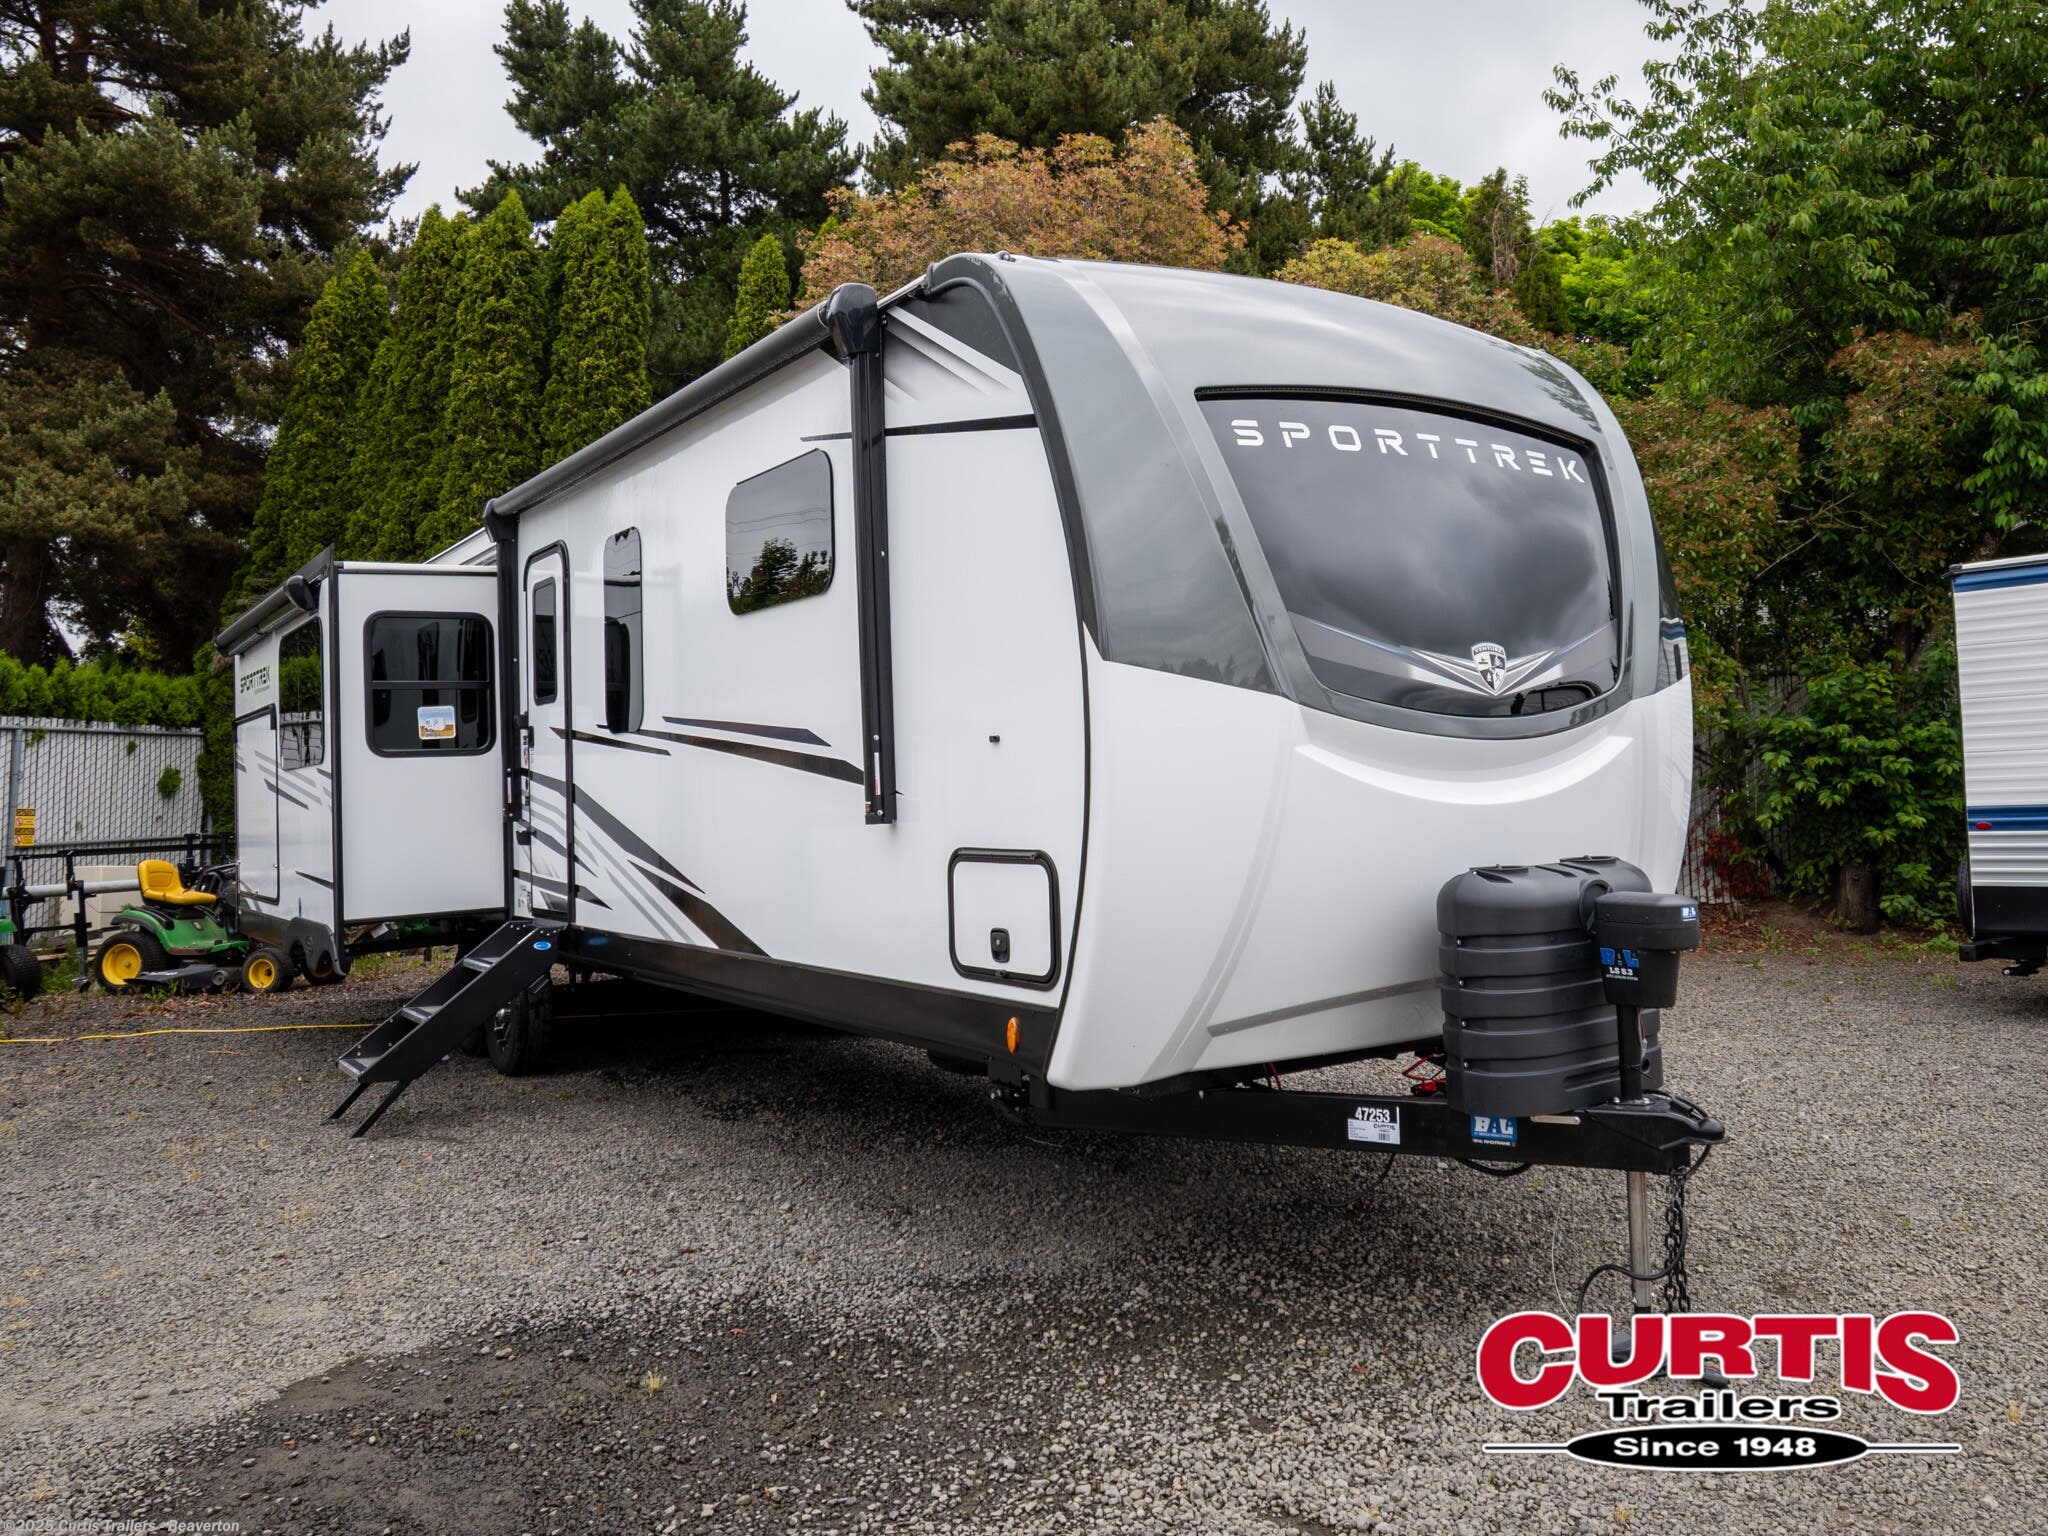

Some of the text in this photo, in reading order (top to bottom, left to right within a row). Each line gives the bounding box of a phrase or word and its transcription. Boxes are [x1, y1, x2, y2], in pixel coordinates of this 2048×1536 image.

[1231, 419, 1586, 484] SPORTTREK
[240, 665, 271, 694] SPORTTREK
[1600, 947, 1640, 968] BAL
[1355, 1106, 1390, 1122] 47253
[1474, 1116, 1514, 1135] BAL
